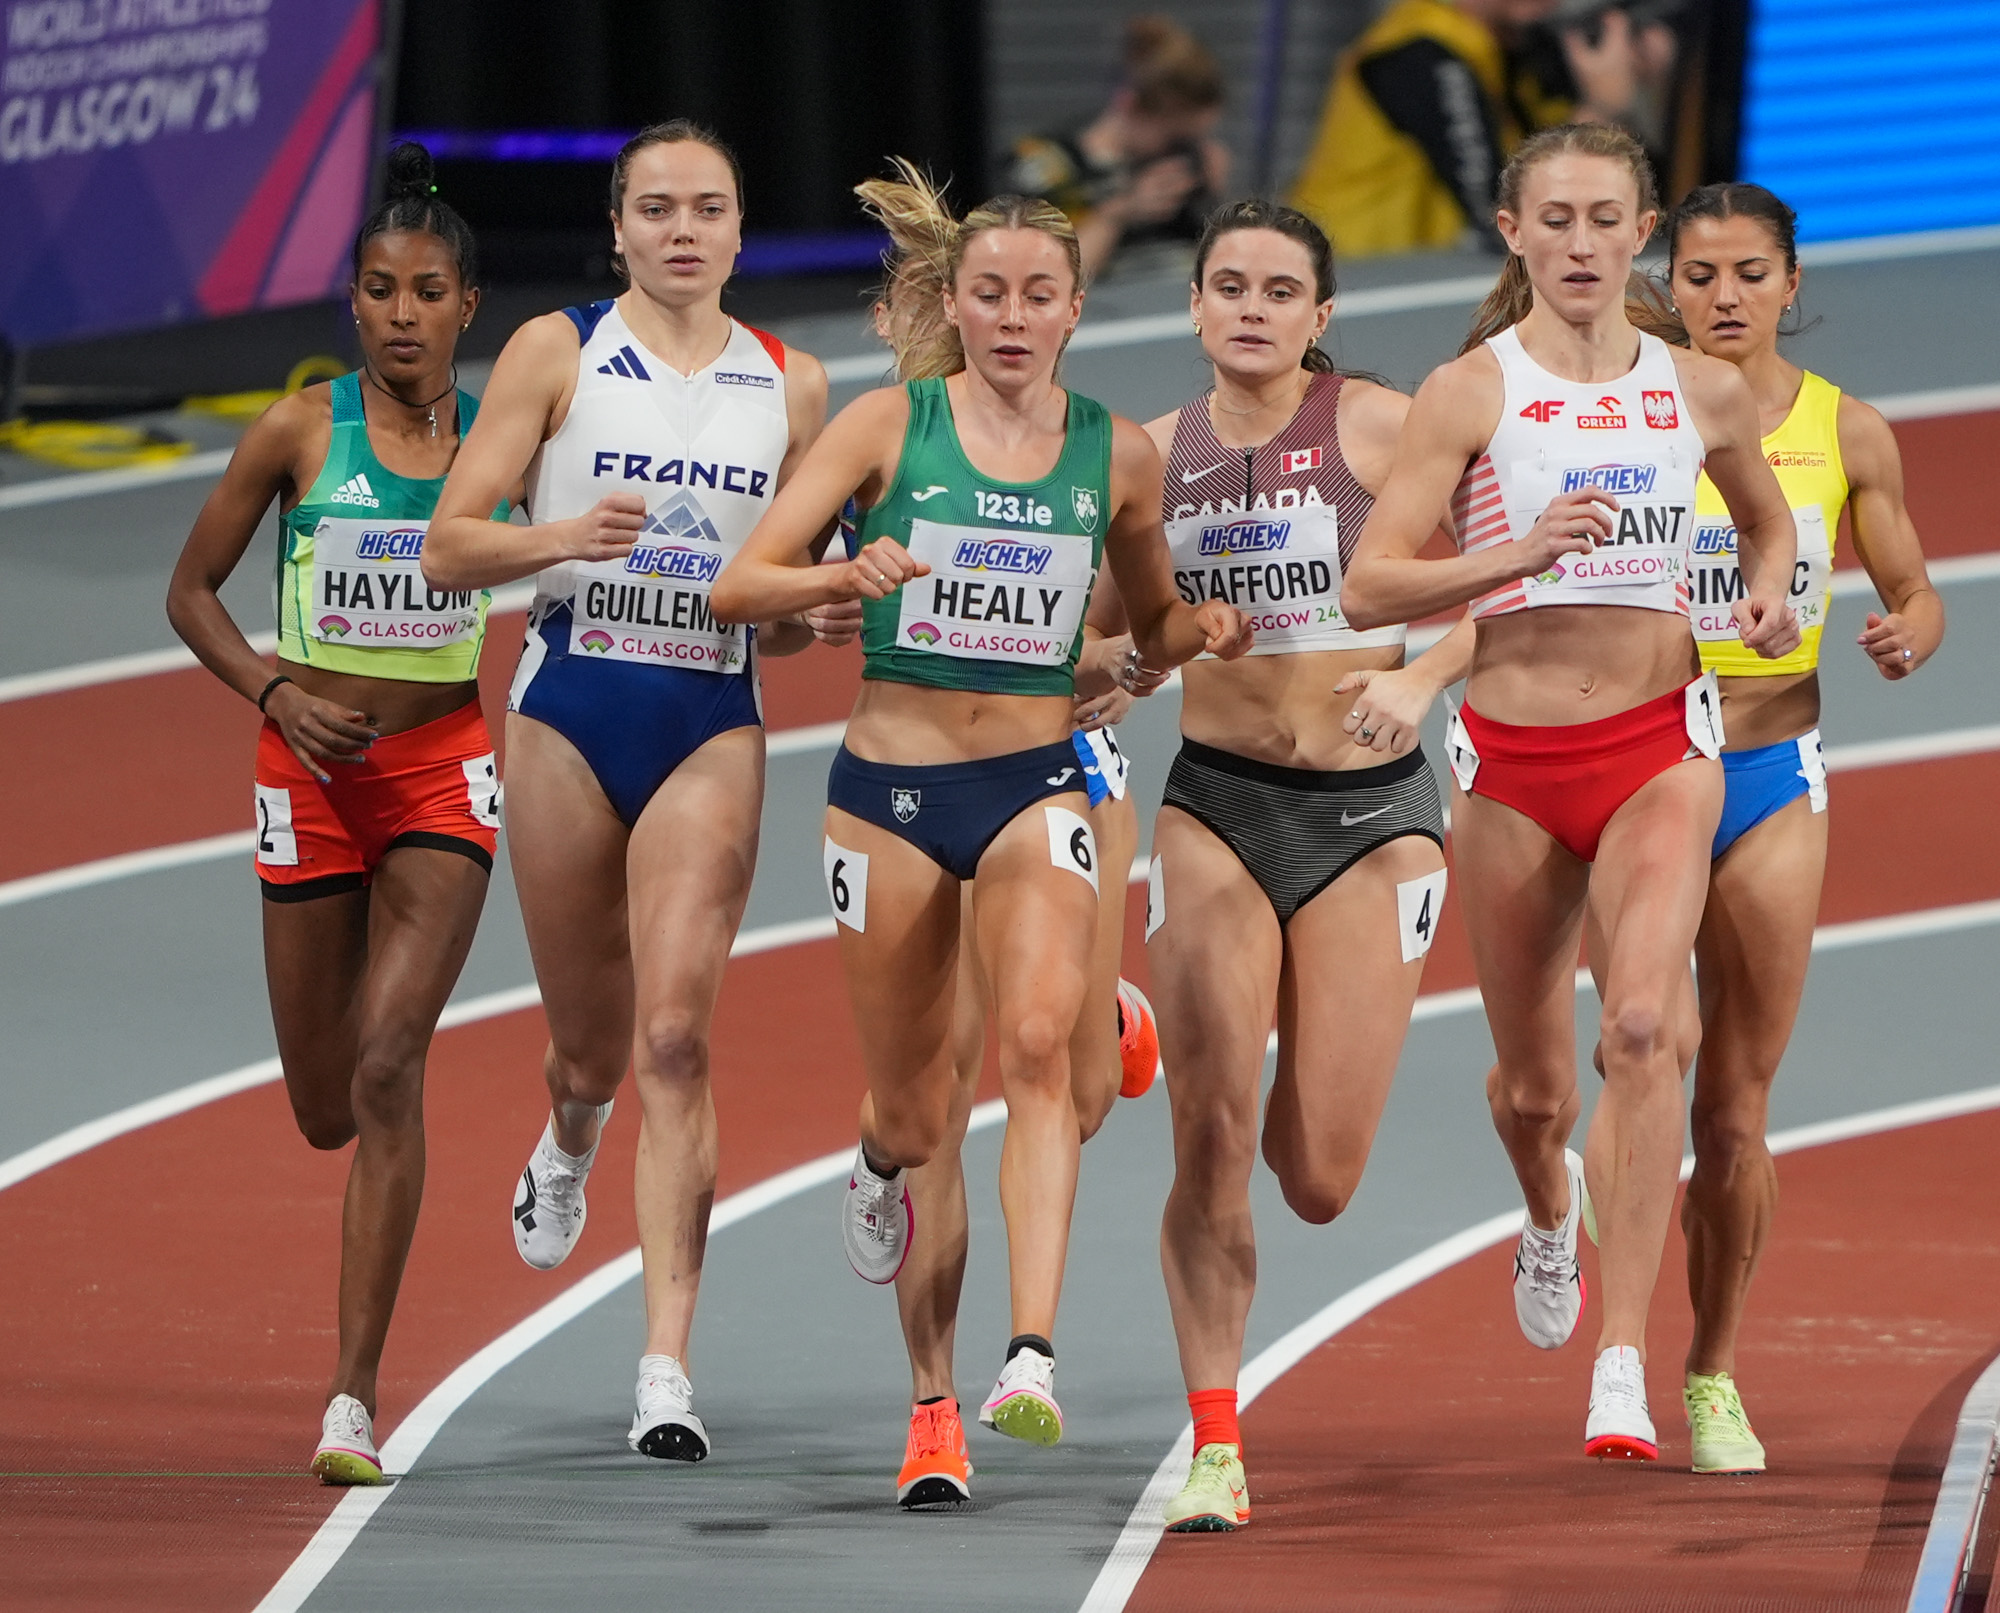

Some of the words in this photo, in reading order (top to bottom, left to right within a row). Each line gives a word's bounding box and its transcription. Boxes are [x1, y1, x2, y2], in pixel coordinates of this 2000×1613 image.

[1579, 416, 1624, 428] ORLEN
[593, 451, 769, 498] FRANCE
[1782, 456, 1827, 468] atletism
[1561, 464, 1657, 496] HI-CHEW
[331, 489, 380, 509] adidas
[974, 491, 1053, 526] 123.ie
[356, 530, 427, 560] HI-CHE
[1198, 520, 1291, 557] HI-CHEW
[1692, 526, 1738, 554] HI-C
[625, 545, 722, 583] HI-CHEW
[952, 539, 1052, 575] HI-CHEW
[1667, 557, 1680, 573] 24
[1174, 560, 1331, 606] STAFFORD
[586, 580, 736, 637] GUILLEM
[933, 578, 1063, 627] HEALY
[1250, 610, 1310, 631] SGOW
[1315, 605, 1339, 623] 24
[1801, 603, 1818, 619] 24
[358, 620, 458, 639] GLASGOW
[948, 632, 1051, 656] GLASGOW
[622, 637, 722, 662] GLASGOW
[720, 650, 739, 665] 24
[259, 797, 274, 853] 2
[1069, 826, 1093, 873] 6
[831, 858, 850, 913] 6
[1416, 887, 1432, 942] 4
